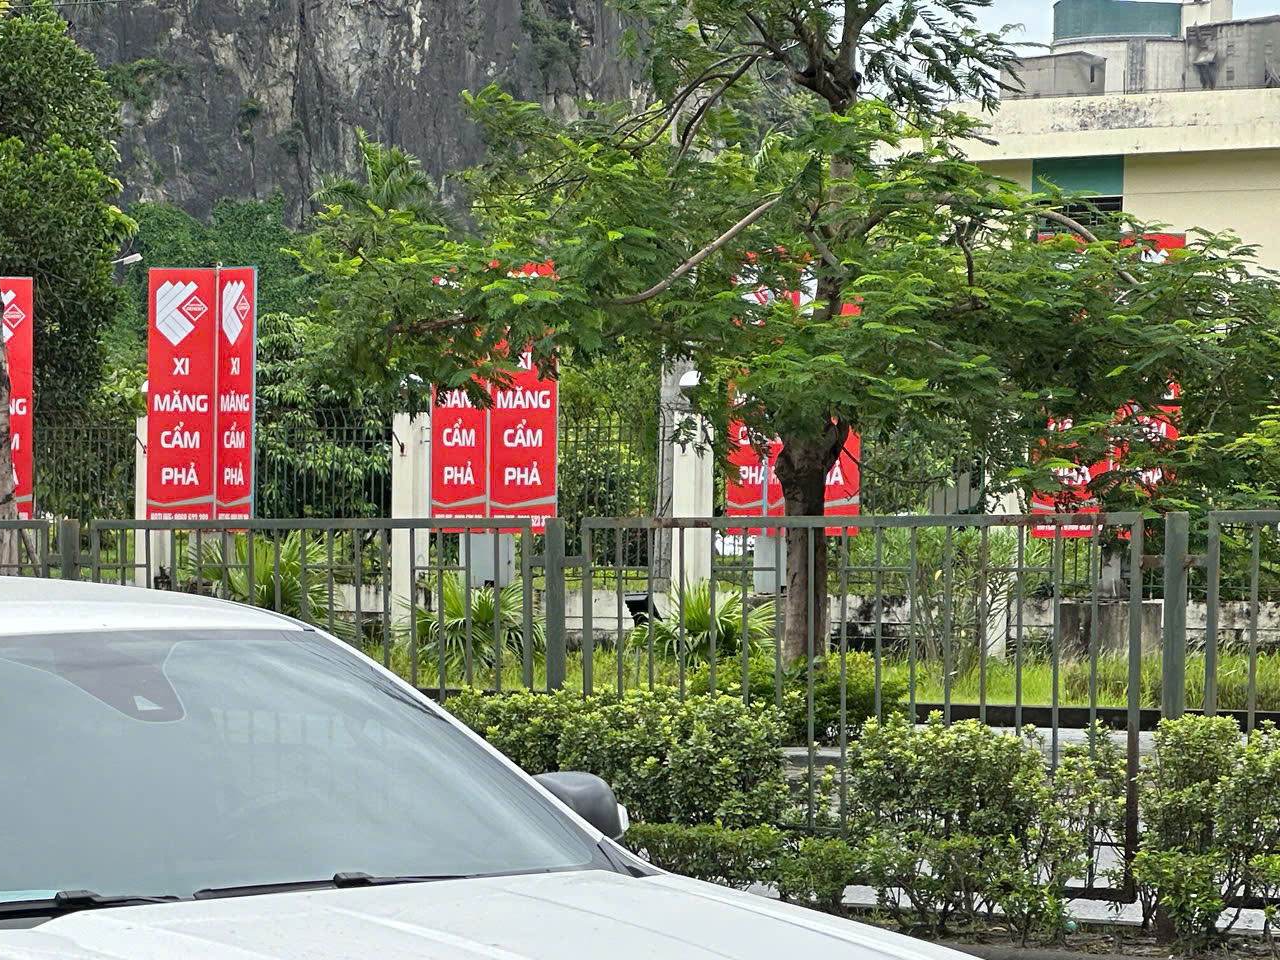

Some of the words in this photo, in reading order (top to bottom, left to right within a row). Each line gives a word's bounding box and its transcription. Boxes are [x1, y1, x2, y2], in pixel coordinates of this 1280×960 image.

[172, 357, 190, 376] XI
[230, 357, 240, 375] XI
[153, 390, 209, 412] MĂNG
[220, 390, 250, 412] MĂNG
[496, 386, 551, 409] MĂNG
[160, 421, 200, 449] CẨM
[223, 421, 245, 449] CẨM
[442, 417, 476, 447] CẨM
[503, 418, 543, 447] CẨM
[161, 462, 200, 486] PHẢ
[223, 462, 245, 486] PHẢ
[443, 460, 475, 485] PHẢ
[504, 460, 542, 486] PHẢ
